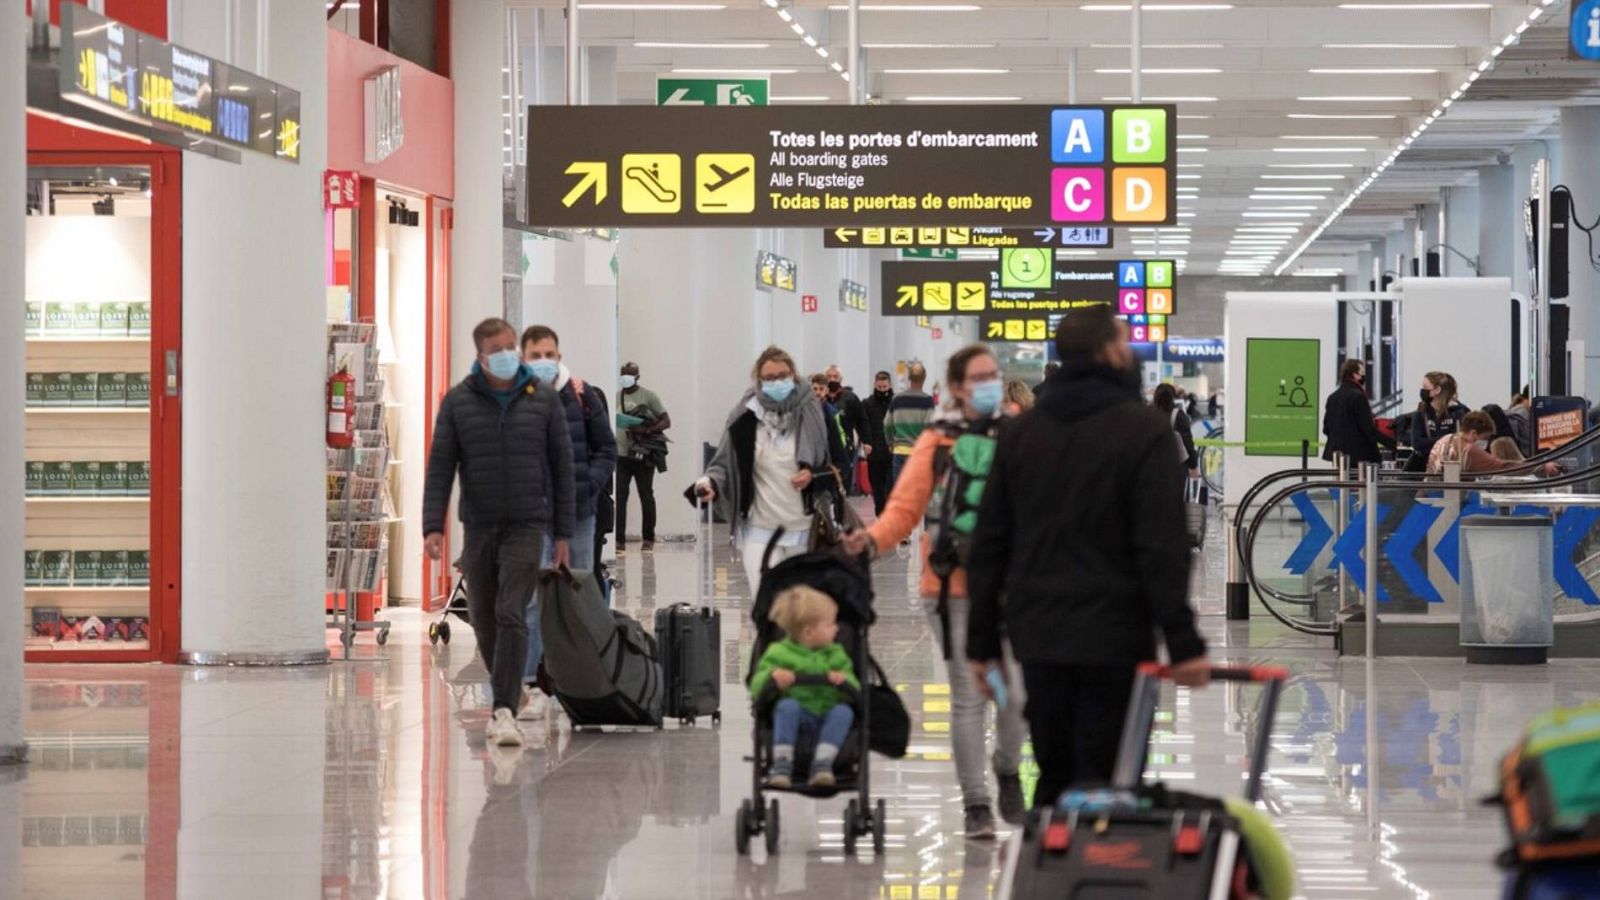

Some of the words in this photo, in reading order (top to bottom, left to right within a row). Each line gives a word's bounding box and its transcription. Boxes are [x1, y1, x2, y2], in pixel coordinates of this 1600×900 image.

[769, 130, 816, 148] Totes
[820, 130, 845, 148] les
[849, 131, 902, 150] portes
[906, 130, 1038, 148] d'embarcament
[1063, 118, 1092, 153] A
[1126, 118, 1152, 153] B
[769, 151, 785, 166] All
[790, 151, 847, 169] boarding
[851, 152, 888, 169] gates
[769, 172, 793, 187] Alle
[798, 172, 864, 190] Flugsteige
[769, 193, 820, 210] Todas
[825, 193, 849, 210] las
[853, 194, 916, 212] puertas
[921, 193, 943, 210] de
[947, 193, 1032, 212] embarque
[1064, 176, 1092, 213] C
[1125, 176, 1153, 213] D
[972, 235, 1018, 247] Llegadas
[1124, 265, 1139, 283] A
[1152, 266, 1165, 283] B
[991, 299, 1015, 309] Todas
[1124, 292, 1139, 310] C
[1152, 292, 1166, 310] D
[1133, 326, 1144, 340] C
[1178, 345, 1225, 356] RYANA
